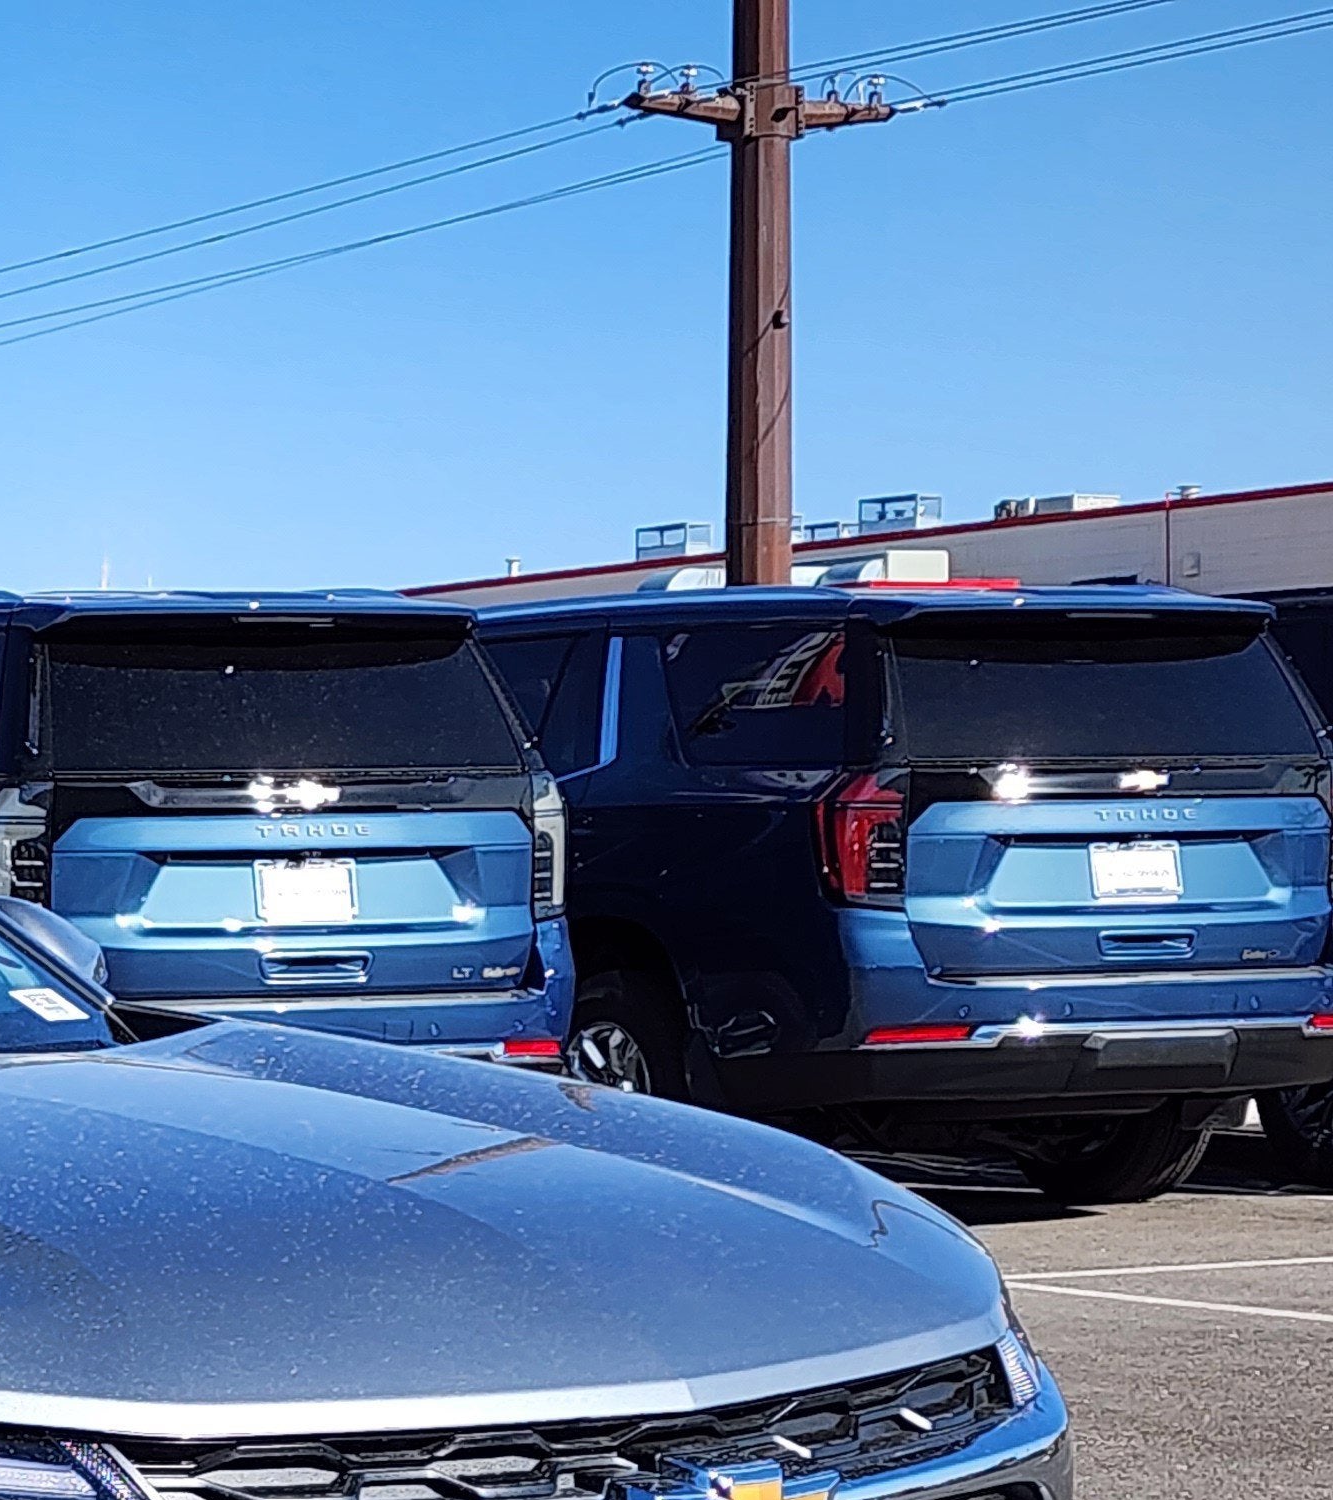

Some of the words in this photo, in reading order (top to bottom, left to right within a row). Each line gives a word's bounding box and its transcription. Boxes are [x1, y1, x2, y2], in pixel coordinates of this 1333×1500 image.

[1094, 807, 1197, 821] TAHOE
[256, 822, 371, 838] TAHOE
[452, 966, 474, 979] LT
